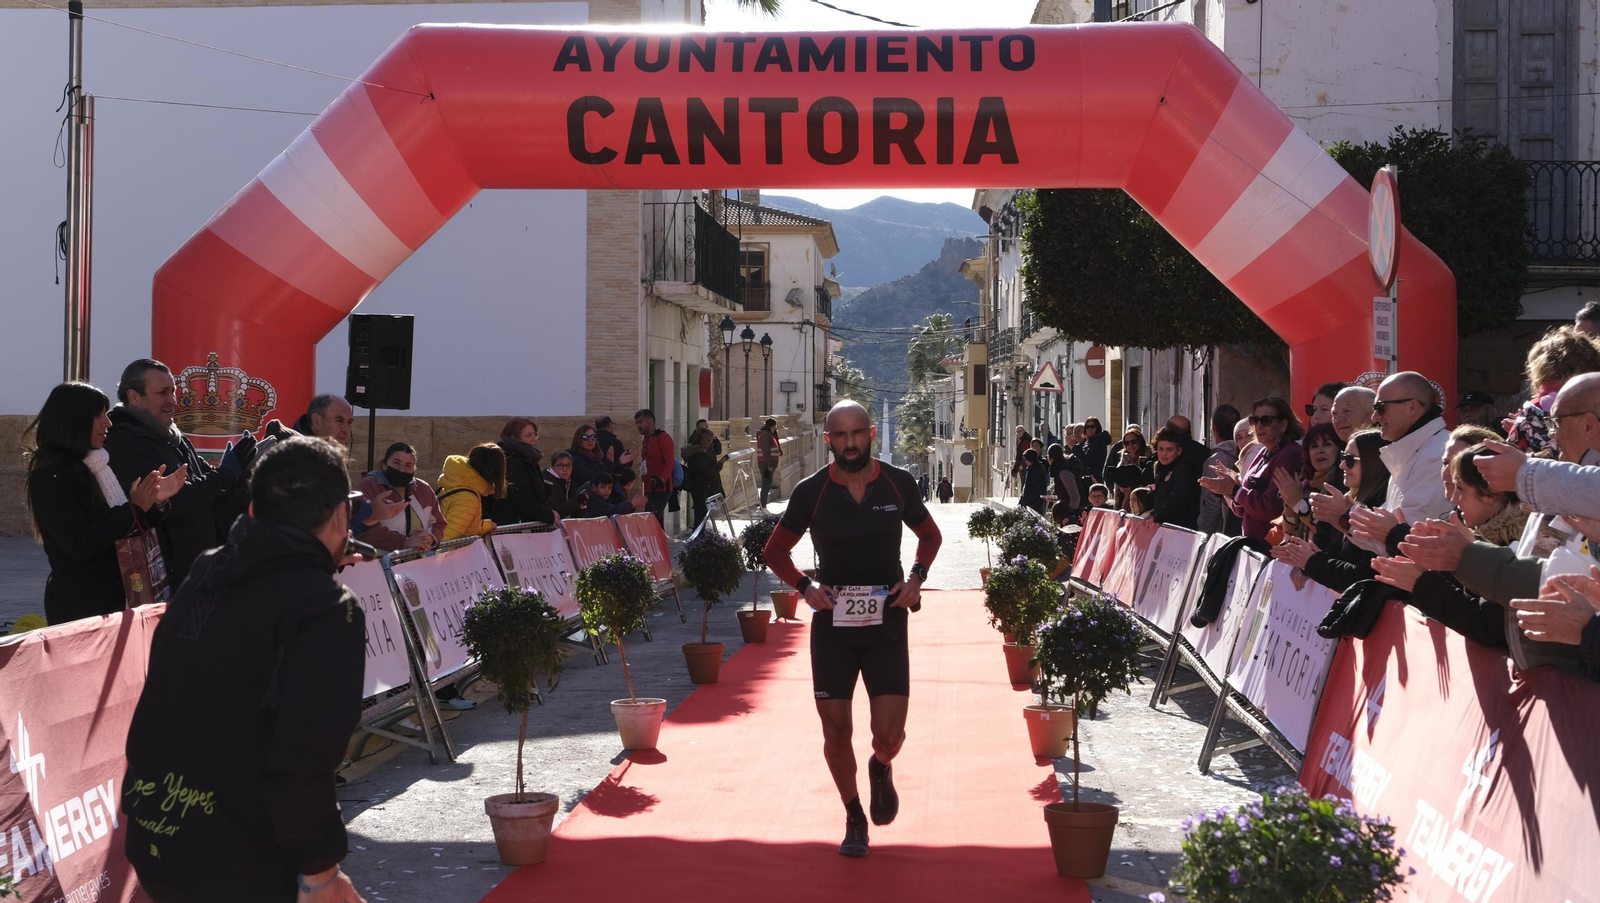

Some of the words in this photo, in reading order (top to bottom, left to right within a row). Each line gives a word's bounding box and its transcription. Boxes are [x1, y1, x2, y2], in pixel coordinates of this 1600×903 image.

[552, 34, 1036, 73] AYUNTAMIENTO
[566, 95, 1020, 166] CANTORIA
[845, 598, 878, 616] 238
[161, 772, 217, 818] Yepes
[1319, 731, 1393, 813] TEAMERGY
[0, 778, 119, 884] EAMERGY
[1405, 797, 1515, 903] TEAMERGY
